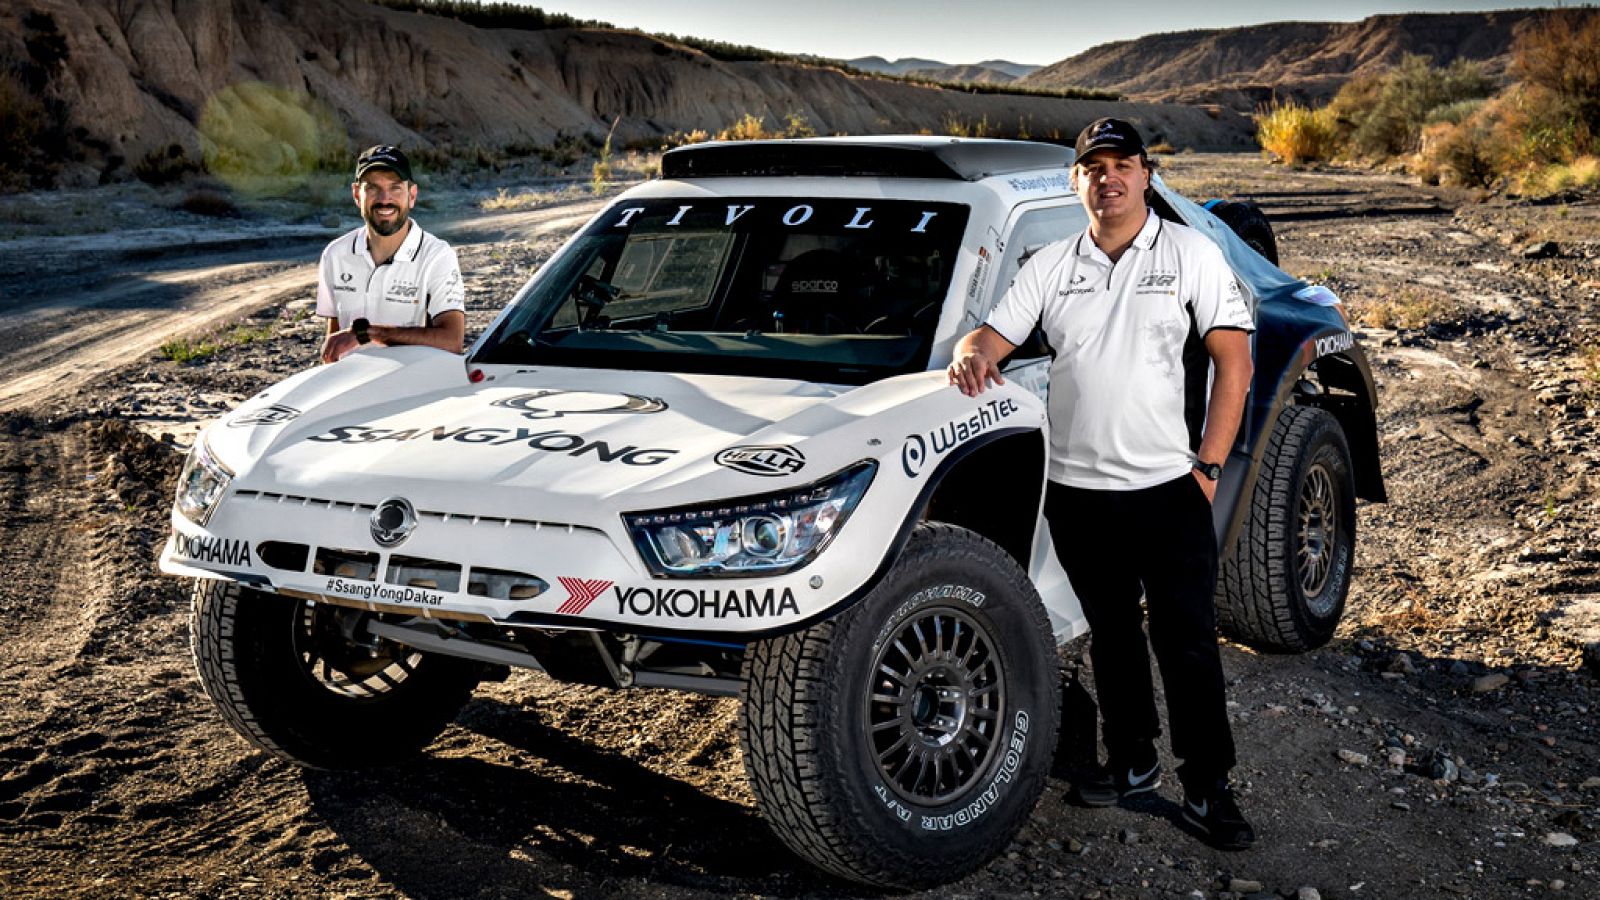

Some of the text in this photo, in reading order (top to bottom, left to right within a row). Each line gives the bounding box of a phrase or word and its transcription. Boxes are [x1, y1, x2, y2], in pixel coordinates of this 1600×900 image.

[614, 205, 937, 233] TIVOLI
[792, 280, 838, 291] sparco
[930, 398, 1018, 454] WashTec
[307, 425, 680, 466] SSANGYONG
[723, 449, 806, 473] HELLA
[326, 578, 443, 606] #SsangYongDakar
[613, 586, 800, 618] YOKOHAMA
[922, 711, 1029, 831] GEOLANDAR
